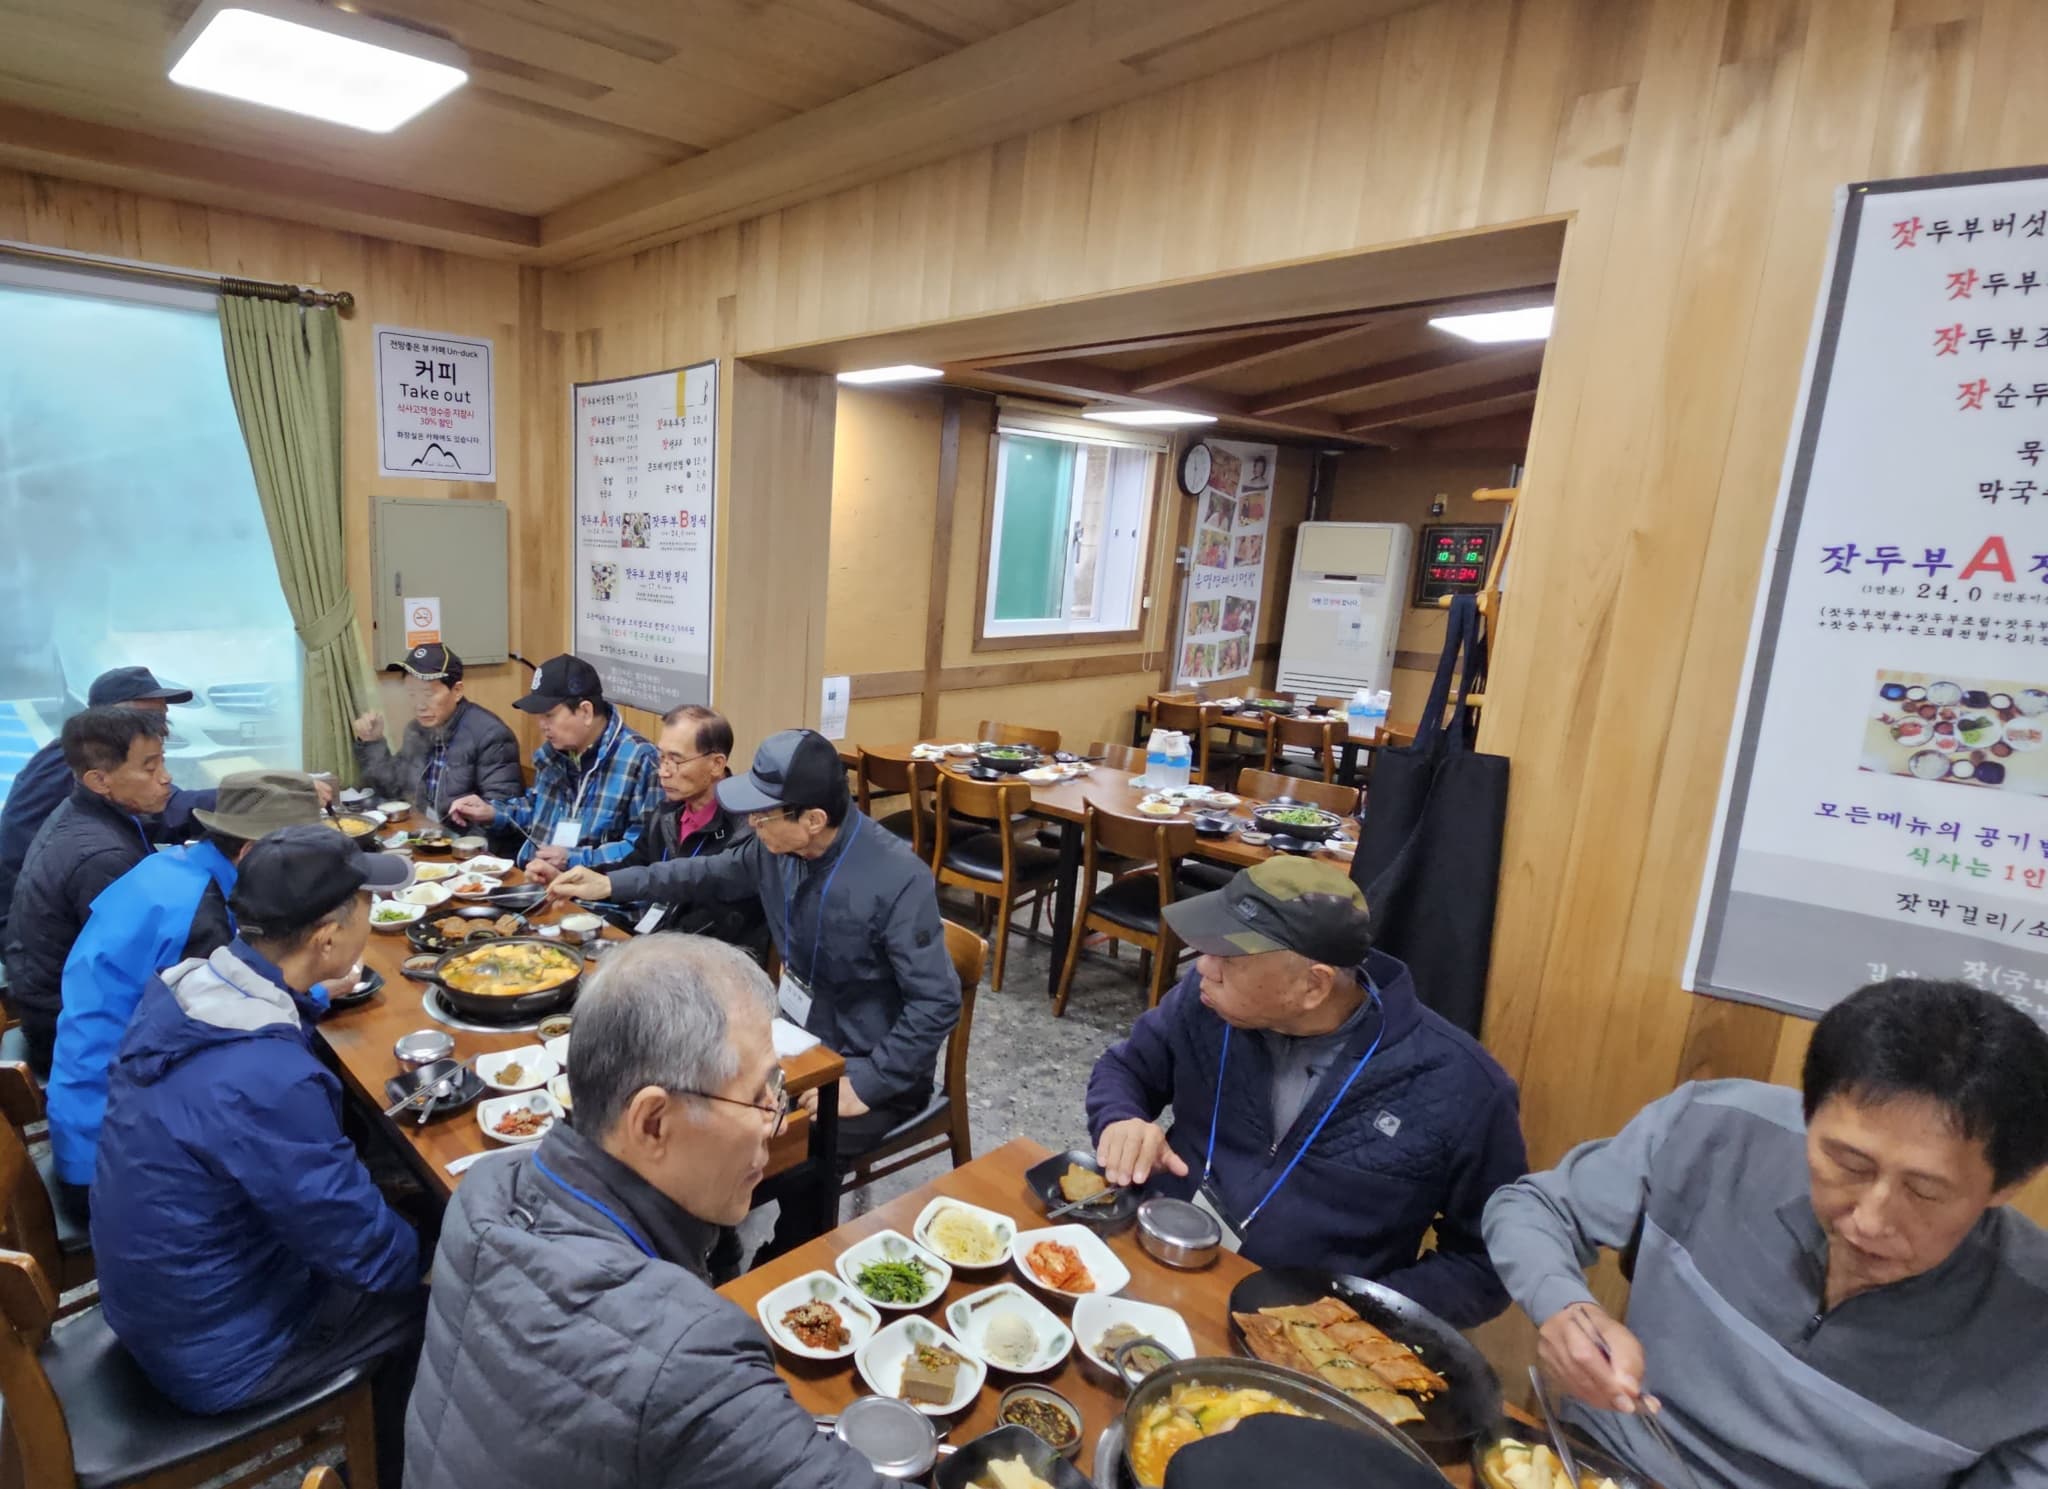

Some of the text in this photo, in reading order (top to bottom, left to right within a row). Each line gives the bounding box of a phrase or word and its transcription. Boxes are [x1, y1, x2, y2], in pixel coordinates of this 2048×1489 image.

[1891, 210, 2048, 250] 잣두부버섯
[415, 360, 456, 386] 커피
[399, 383, 472, 404] Take out
[397, 403, 475, 420] 식사고객 영수증 지참시
[419, 417, 453, 429] 30% 할인
[397, 431, 424, 441] 화장실은
[454, 435, 479, 444] 있습니다
[1979, 479, 2048, 505] 막국
[1438, 551, 1449, 562] 10
[1465, 551, 1478, 562] 19
[1917, 583, 1982, 603] 24.0
[1814, 802, 1961, 842] 모든메뉴의
[1907, 847, 1992, 878] 식사는
